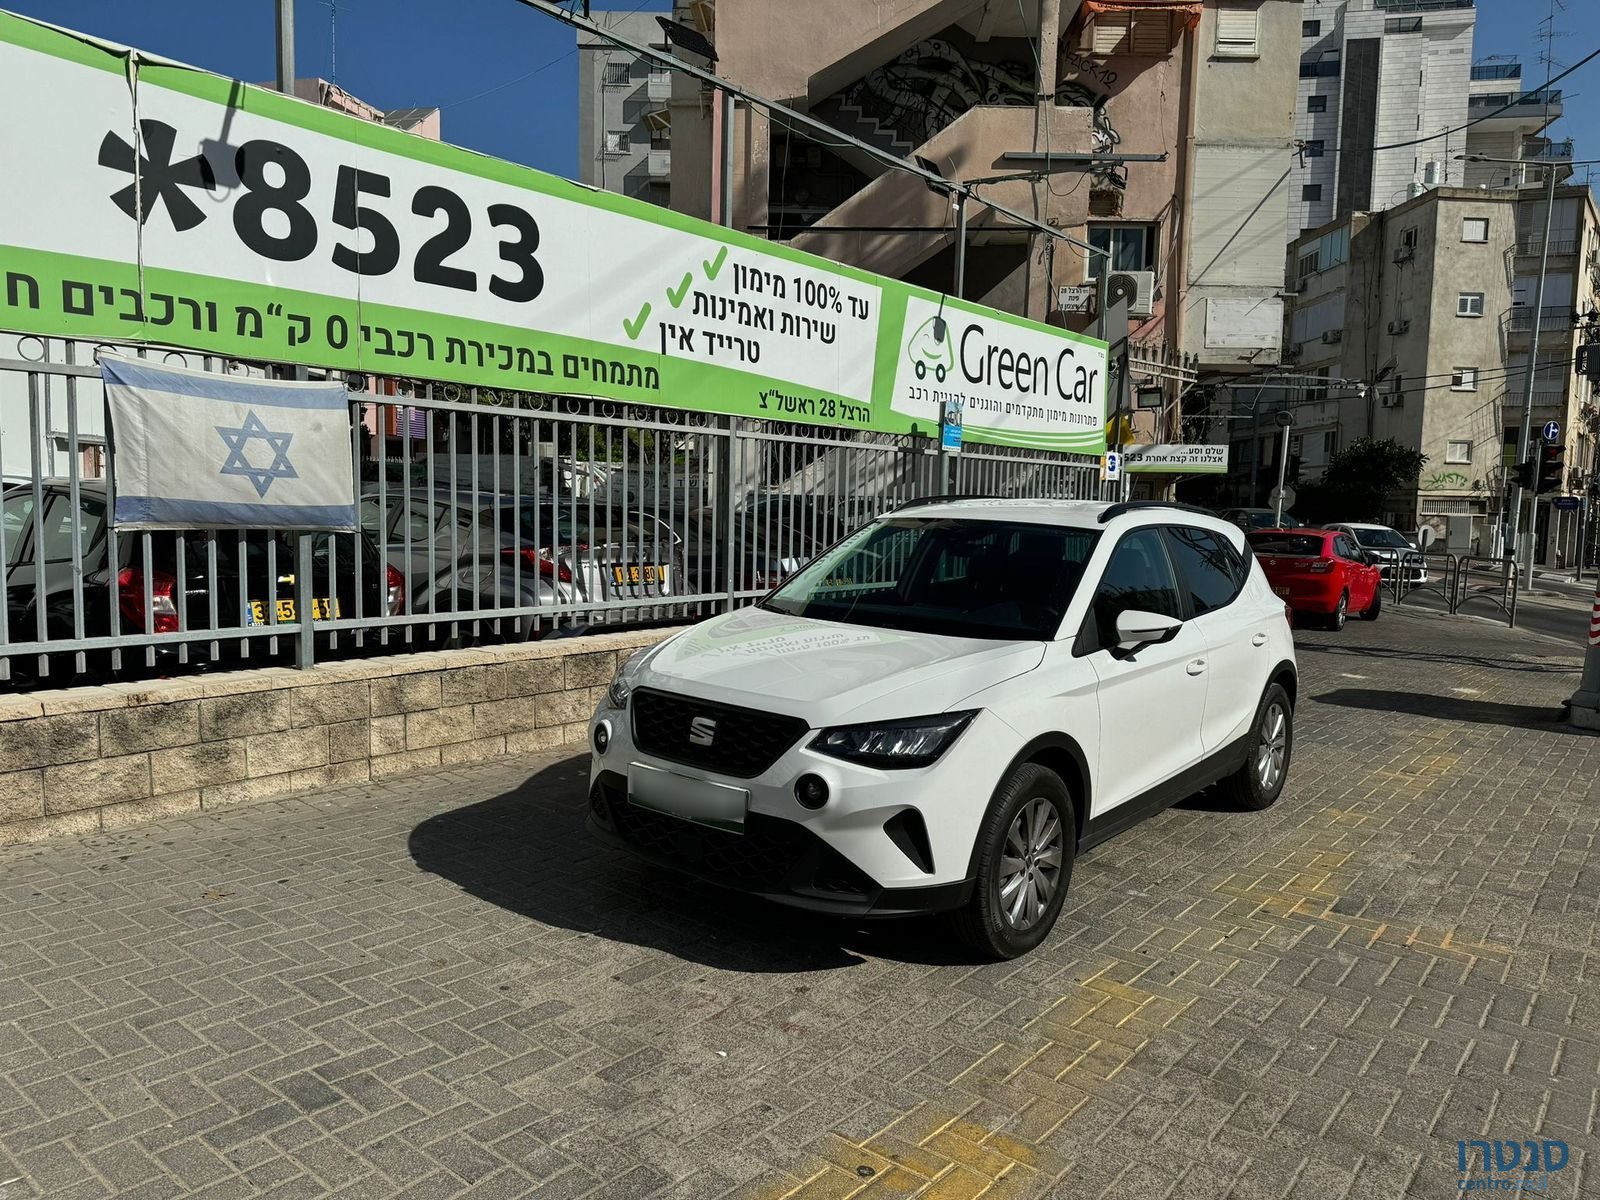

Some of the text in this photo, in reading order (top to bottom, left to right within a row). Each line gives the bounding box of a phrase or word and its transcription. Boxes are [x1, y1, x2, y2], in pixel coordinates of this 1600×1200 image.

[733, 263, 869, 320] עד 100% מימון
[62, 280, 217, 333] ורכבים
[692, 290, 836, 344] שירות ואמינות
[327, 314, 349, 350] 0
[360, 325, 434, 360] רכבי
[659, 322, 760, 363] טרייד אין
[445, 336, 554, 376] במכירת
[960, 324, 1098, 404] Green Car
[563, 353, 660, 390] מתמחים
[909, 386, 929, 402] רכב
[970, 397, 1002, 413] והוגנים
[819, 398, 836, 417] 28
[839, 400, 870, 424] הרצל
[1005, 402, 1044, 420] מתקדמים
[1046, 409, 1067, 423] מימון
[1069, 412, 1097, 426] פתרונות
[1170, 456, 1187, 464] קצת
[1201, 455, 1223, 463] אצלנו
[1205, 447, 1224, 455] שלם
